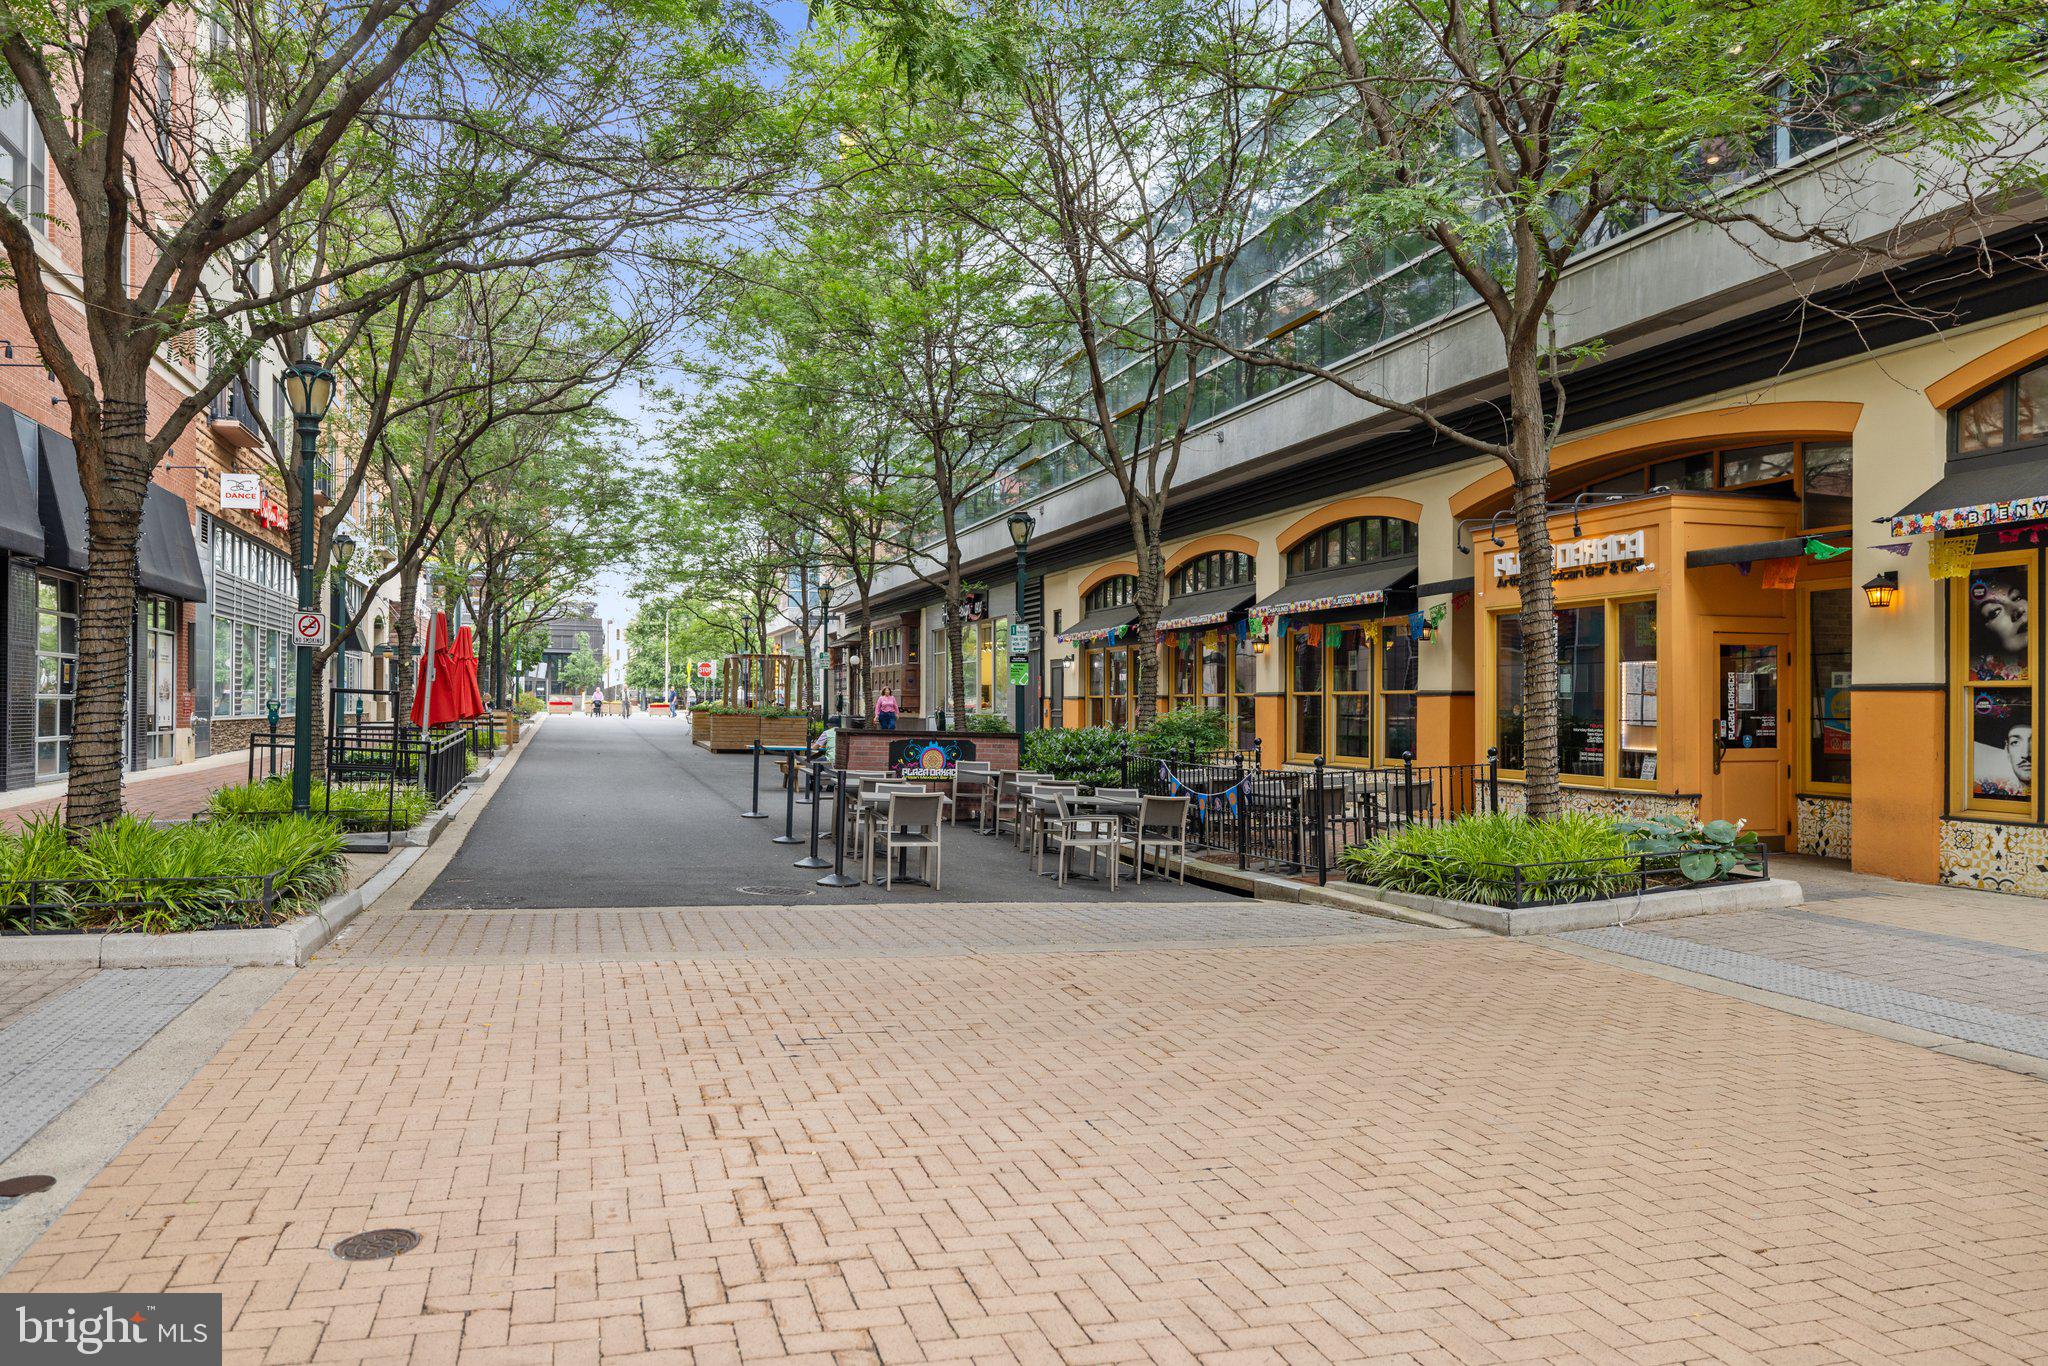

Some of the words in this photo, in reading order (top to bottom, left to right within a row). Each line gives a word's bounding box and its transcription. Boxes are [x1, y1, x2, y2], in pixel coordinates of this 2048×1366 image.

[1967, 500, 2048, 524] BIENV
[1557, 530, 1645, 568] OAXACA
[1585, 564, 1607, 577] Bar
[1609, 561, 1619, 574] &
[902, 768, 929, 776] PLAZA
